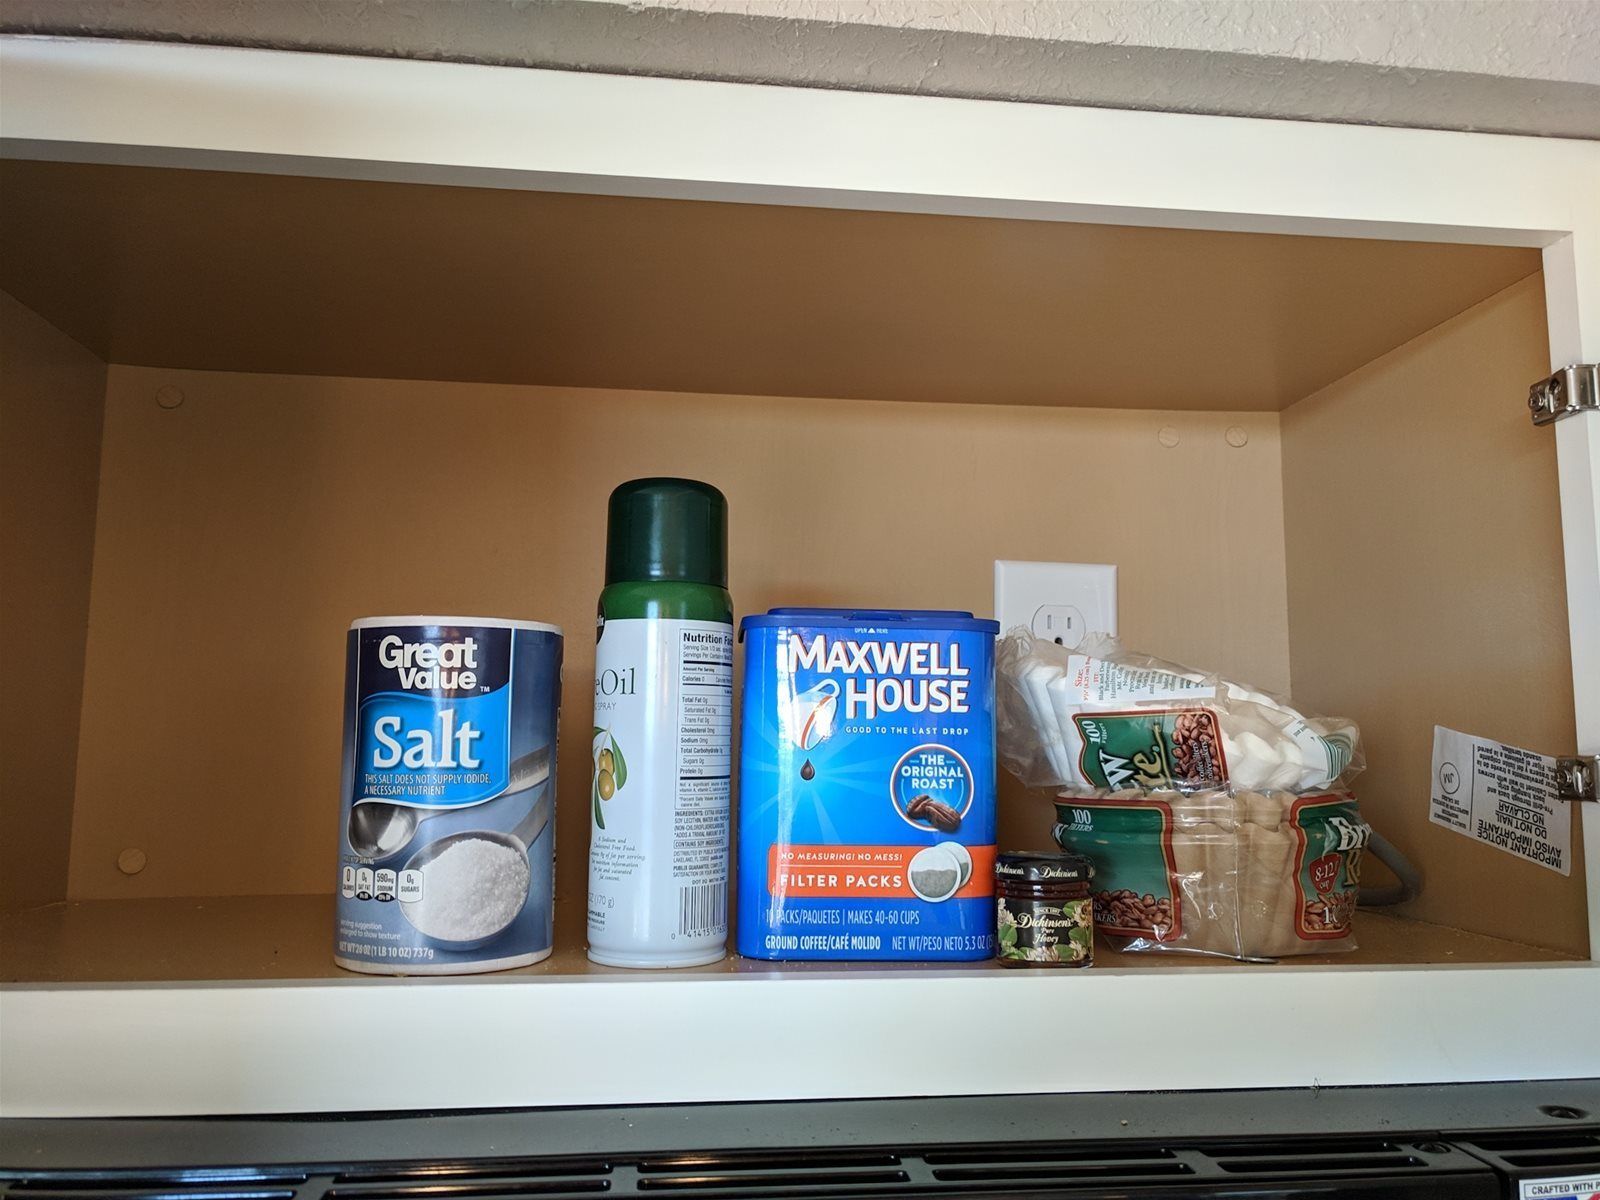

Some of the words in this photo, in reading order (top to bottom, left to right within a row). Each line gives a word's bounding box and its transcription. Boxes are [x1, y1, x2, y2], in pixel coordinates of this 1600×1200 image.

[683, 632, 722, 644] Nutrition
[379, 635, 477, 668] Great
[788, 634, 970, 676] MAXWELL
[398, 667, 476, 689] Value
[845, 678, 970, 720] HOUSE
[845, 726, 871, 734] GOOD
[876, 726, 887, 734] TO
[890, 727, 908, 735] THE
[912, 727, 937, 735] LAST
[942, 727, 969, 735] DROP
[1081, 720, 1101, 745] 100
[374, 709, 480, 768] Salt
[920, 754, 945, 766] THE
[365, 774, 379, 783] THIS
[379, 774, 393, 784] SALT
[395, 774, 413, 784] DOES
[416, 774, 430, 784] NOT
[433, 774, 462, 784] SUPPLY
[901, 766, 964, 778] ORIGINAL
[364, 786, 369, 794] A
[370, 786, 405, 795] NECESSARY
[408, 786, 445, 795] NUTRIENT
[912, 778, 954, 789] ROAST
[1072, 809, 1091, 824] 100
[1498, 802, 1531, 820] CLAVAR
[1495, 812, 1513, 827] NAIL
[1514, 820, 1533, 834] NOT
[1532, 813, 1545, 826] NO
[1477, 829, 1508, 848] NOTICE
[1478, 819, 1532, 846] IMPORTANTE
[1534, 827, 1547, 839] DO
[1510, 842, 1562, 869] IMPORTANT
[1535, 839, 1562, 858] AVISO
[781, 852, 794, 860] NO
[797, 852, 855, 861] MEASURING!
[858, 853, 871, 861] NO
[874, 853, 902, 861] MESS!
[1315, 862, 1335, 882] 8-12
[780, 874, 837, 887] FILTER
[846, 874, 902, 888] PACKS
[1319, 878, 1331, 890] cup
[848, 910, 872, 925] MAKES
[875, 910, 898, 925] 40-60
[901, 910, 920, 925] CUPS
[1017, 912, 1074, 928] Dickinson's
[378, 932, 400, 940] texture
[765, 935, 798, 950] GROUND
[800, 933, 849, 951] COFFEE/CAFÉ
[851, 935, 880, 950] MOLIDO
[892, 937, 906, 950] NET
[908, 937, 942, 951] WT/PESO
[944, 937, 963, 950] NETO
[964, 936, 976, 950] 5.3
[977, 936, 986, 949] OZ
[1033, 933, 1059, 944] Honey
[347, 942, 355, 952] WT
[379, 947, 387, 957] LB
[388, 947, 397, 957] 10
[399, 947, 411, 959] OZ)
[413, 947, 434, 960] 737g
[1531, 1184, 1570, 1195] CRAFTED
[1573, 1181, 1593, 1192] WITH
